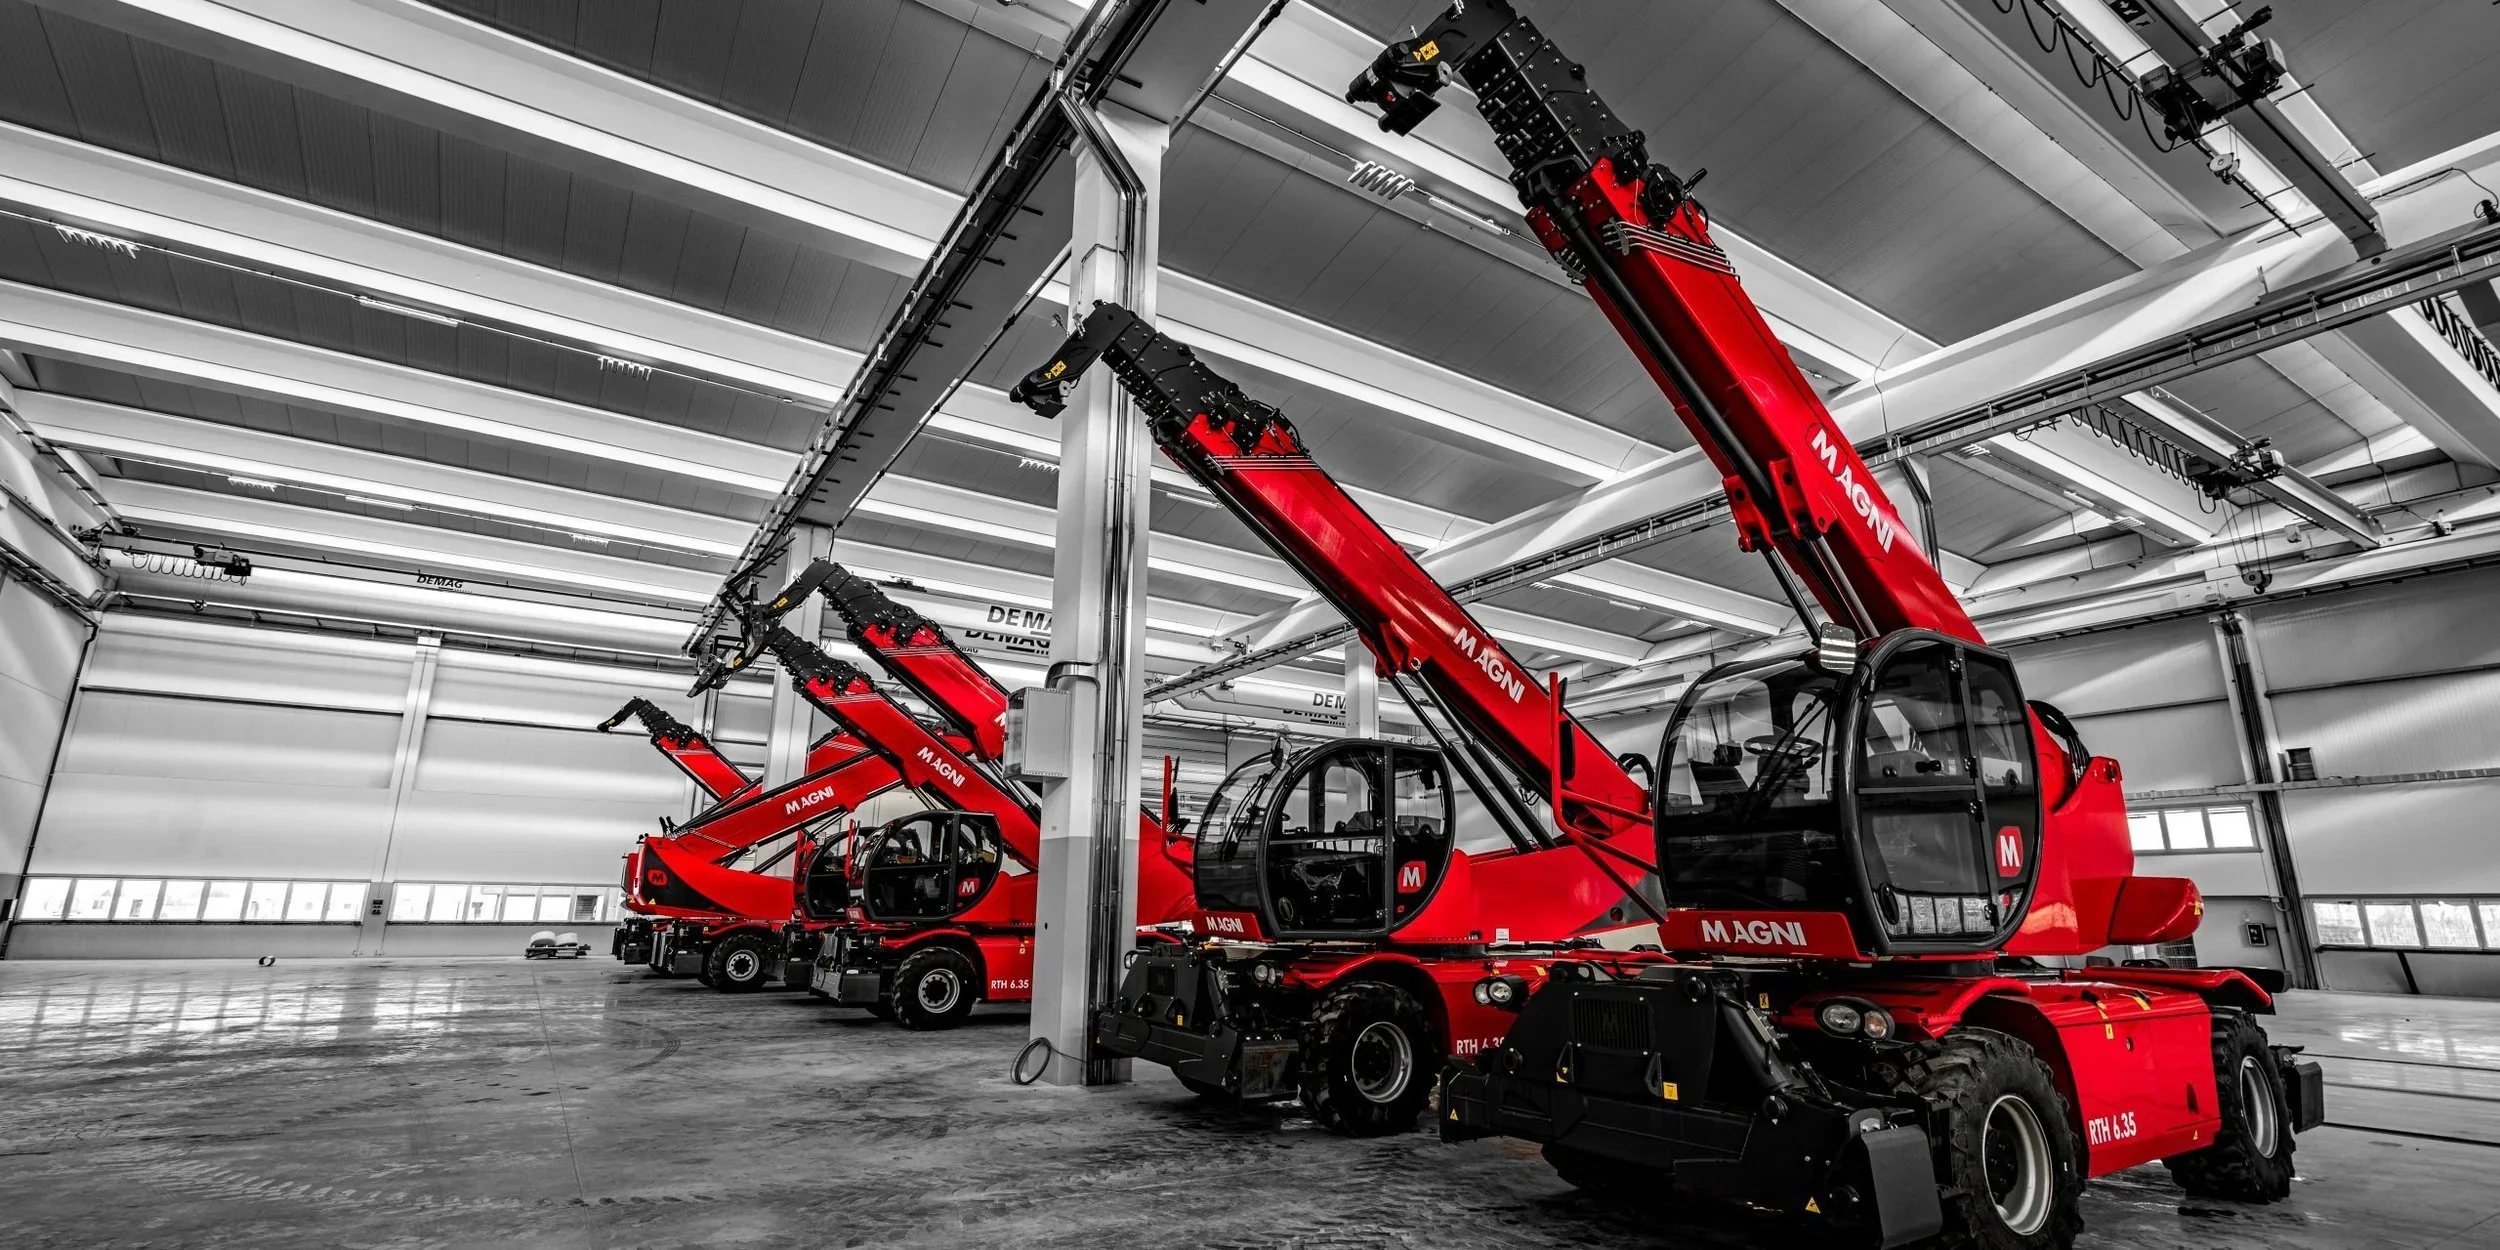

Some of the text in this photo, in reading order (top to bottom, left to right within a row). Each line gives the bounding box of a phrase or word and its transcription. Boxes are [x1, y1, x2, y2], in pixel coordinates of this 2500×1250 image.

[1811, 428, 1895, 553] MAGNI
[416, 575, 463, 589] DEMAG
[986, 605, 1052, 631] DEM
[1453, 626, 1525, 704] MAGNI
[1312, 692, 1347, 710] DEM
[917, 746, 966, 788] MAGNI
[785, 785, 835, 815] MAGNI
[2000, 835, 2021, 867] M
[961, 881, 976, 893] M
[1402, 866, 1421, 887] M
[1205, 916, 1244, 933] MAGNI
[1701, 919, 1807, 946] MAGNI
[991, 979, 1029, 989] RTH 6.35
[1456, 1038, 1478, 1054] RTH
[2088, 1111, 2137, 1145] RTH 6.35
